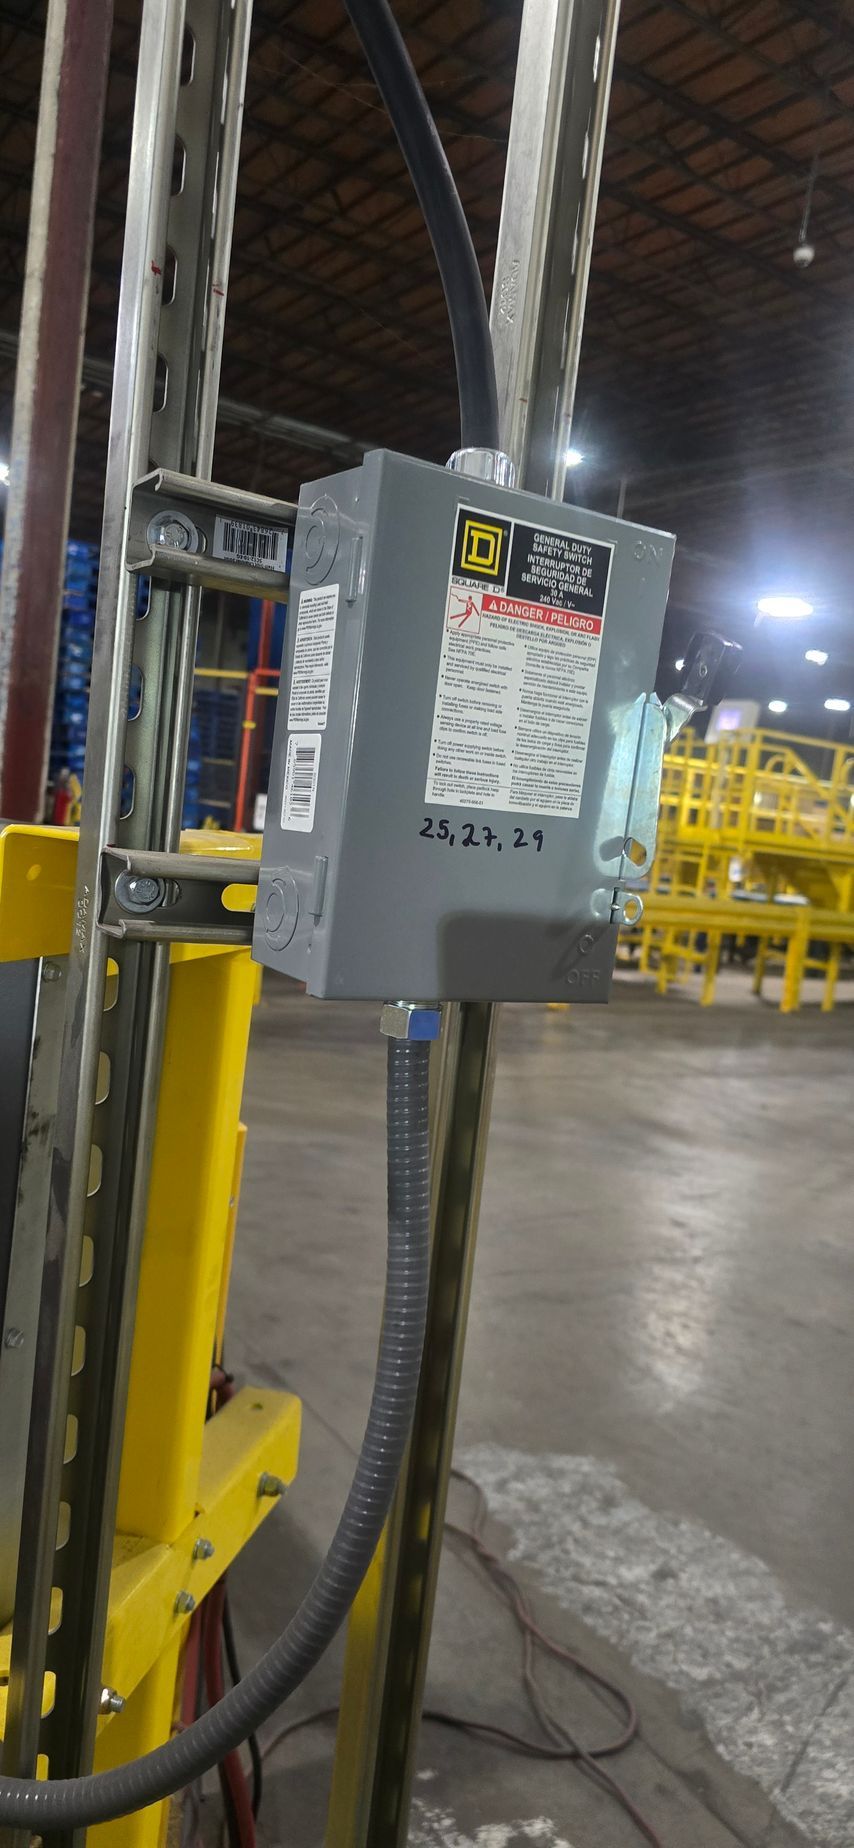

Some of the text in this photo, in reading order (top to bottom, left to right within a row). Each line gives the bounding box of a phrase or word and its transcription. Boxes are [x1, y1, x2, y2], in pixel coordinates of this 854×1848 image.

[467, 528, 496, 566] D
[532, 542, 592, 565] SAFETY SWITCH
[533, 532, 591, 556] GENERAL DUTY
[527, 553, 592, 578] INTERRUPTOR DE
[530, 564, 587, 586] SEGURIDAD DE
[451, 576, 488, 591] SQUARE
[520, 572, 593, 597] SERVICIO GENERAL
[549, 588, 564, 598] 30 A
[539, 594, 550, 603] 240
[563, 599, 566, 607] /
[499, 600, 593, 631] DANGER / PELIGRO
[419, 817, 543, 852] 25, 27, 29
[566, 968, 601, 985] OFF
